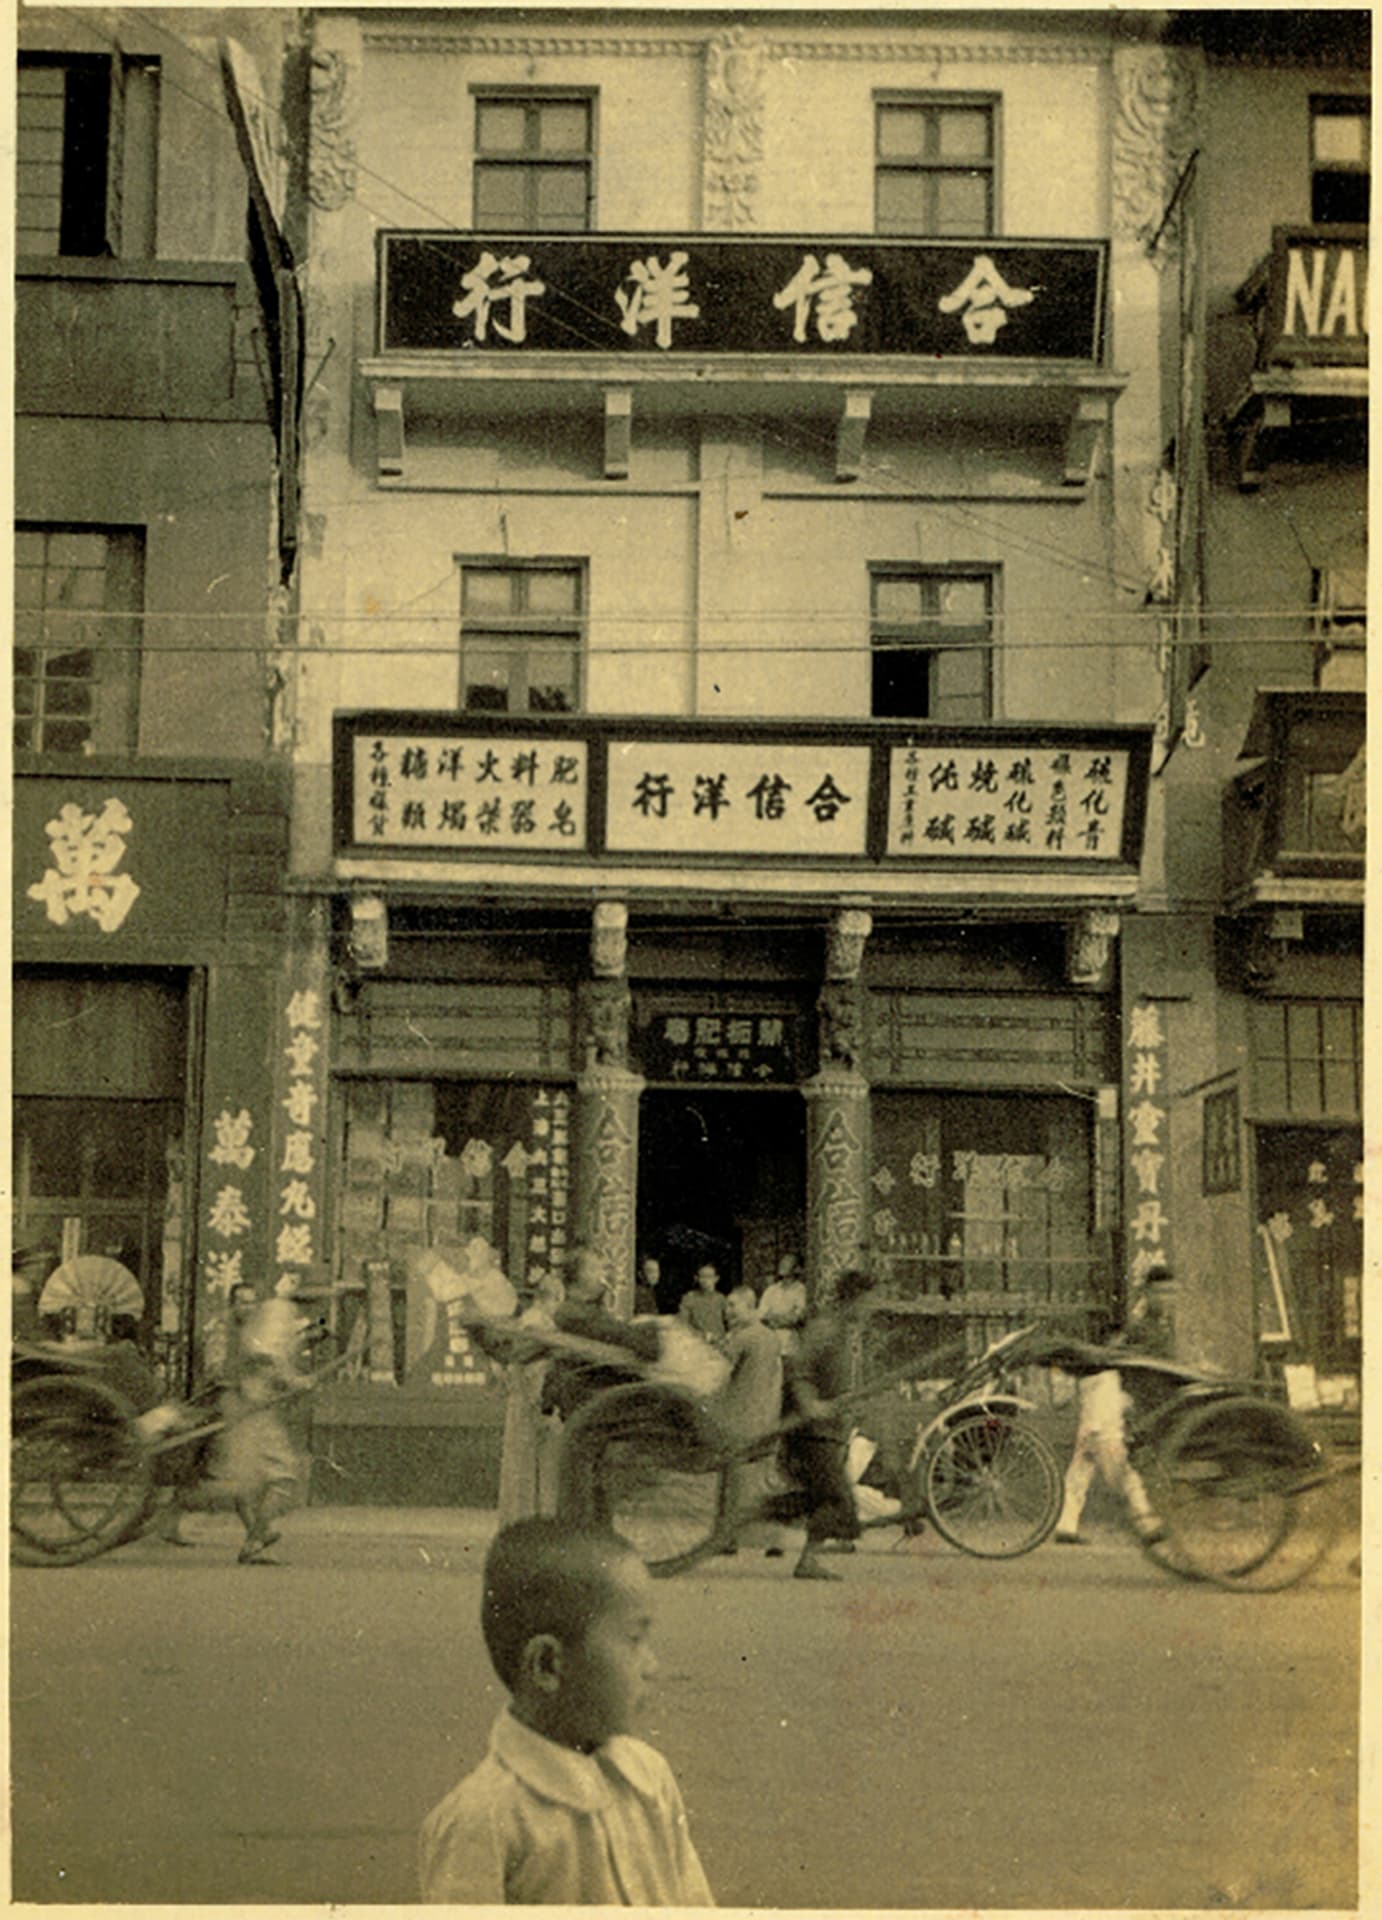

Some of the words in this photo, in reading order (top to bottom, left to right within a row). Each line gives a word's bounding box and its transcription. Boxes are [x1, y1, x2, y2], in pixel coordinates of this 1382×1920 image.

[453, 251, 1035, 349] 合信洋行
[1282, 247, 1369, 336] NA
[630, 771, 852, 822] 合信洋行
[27, 797, 140, 933] 萬
